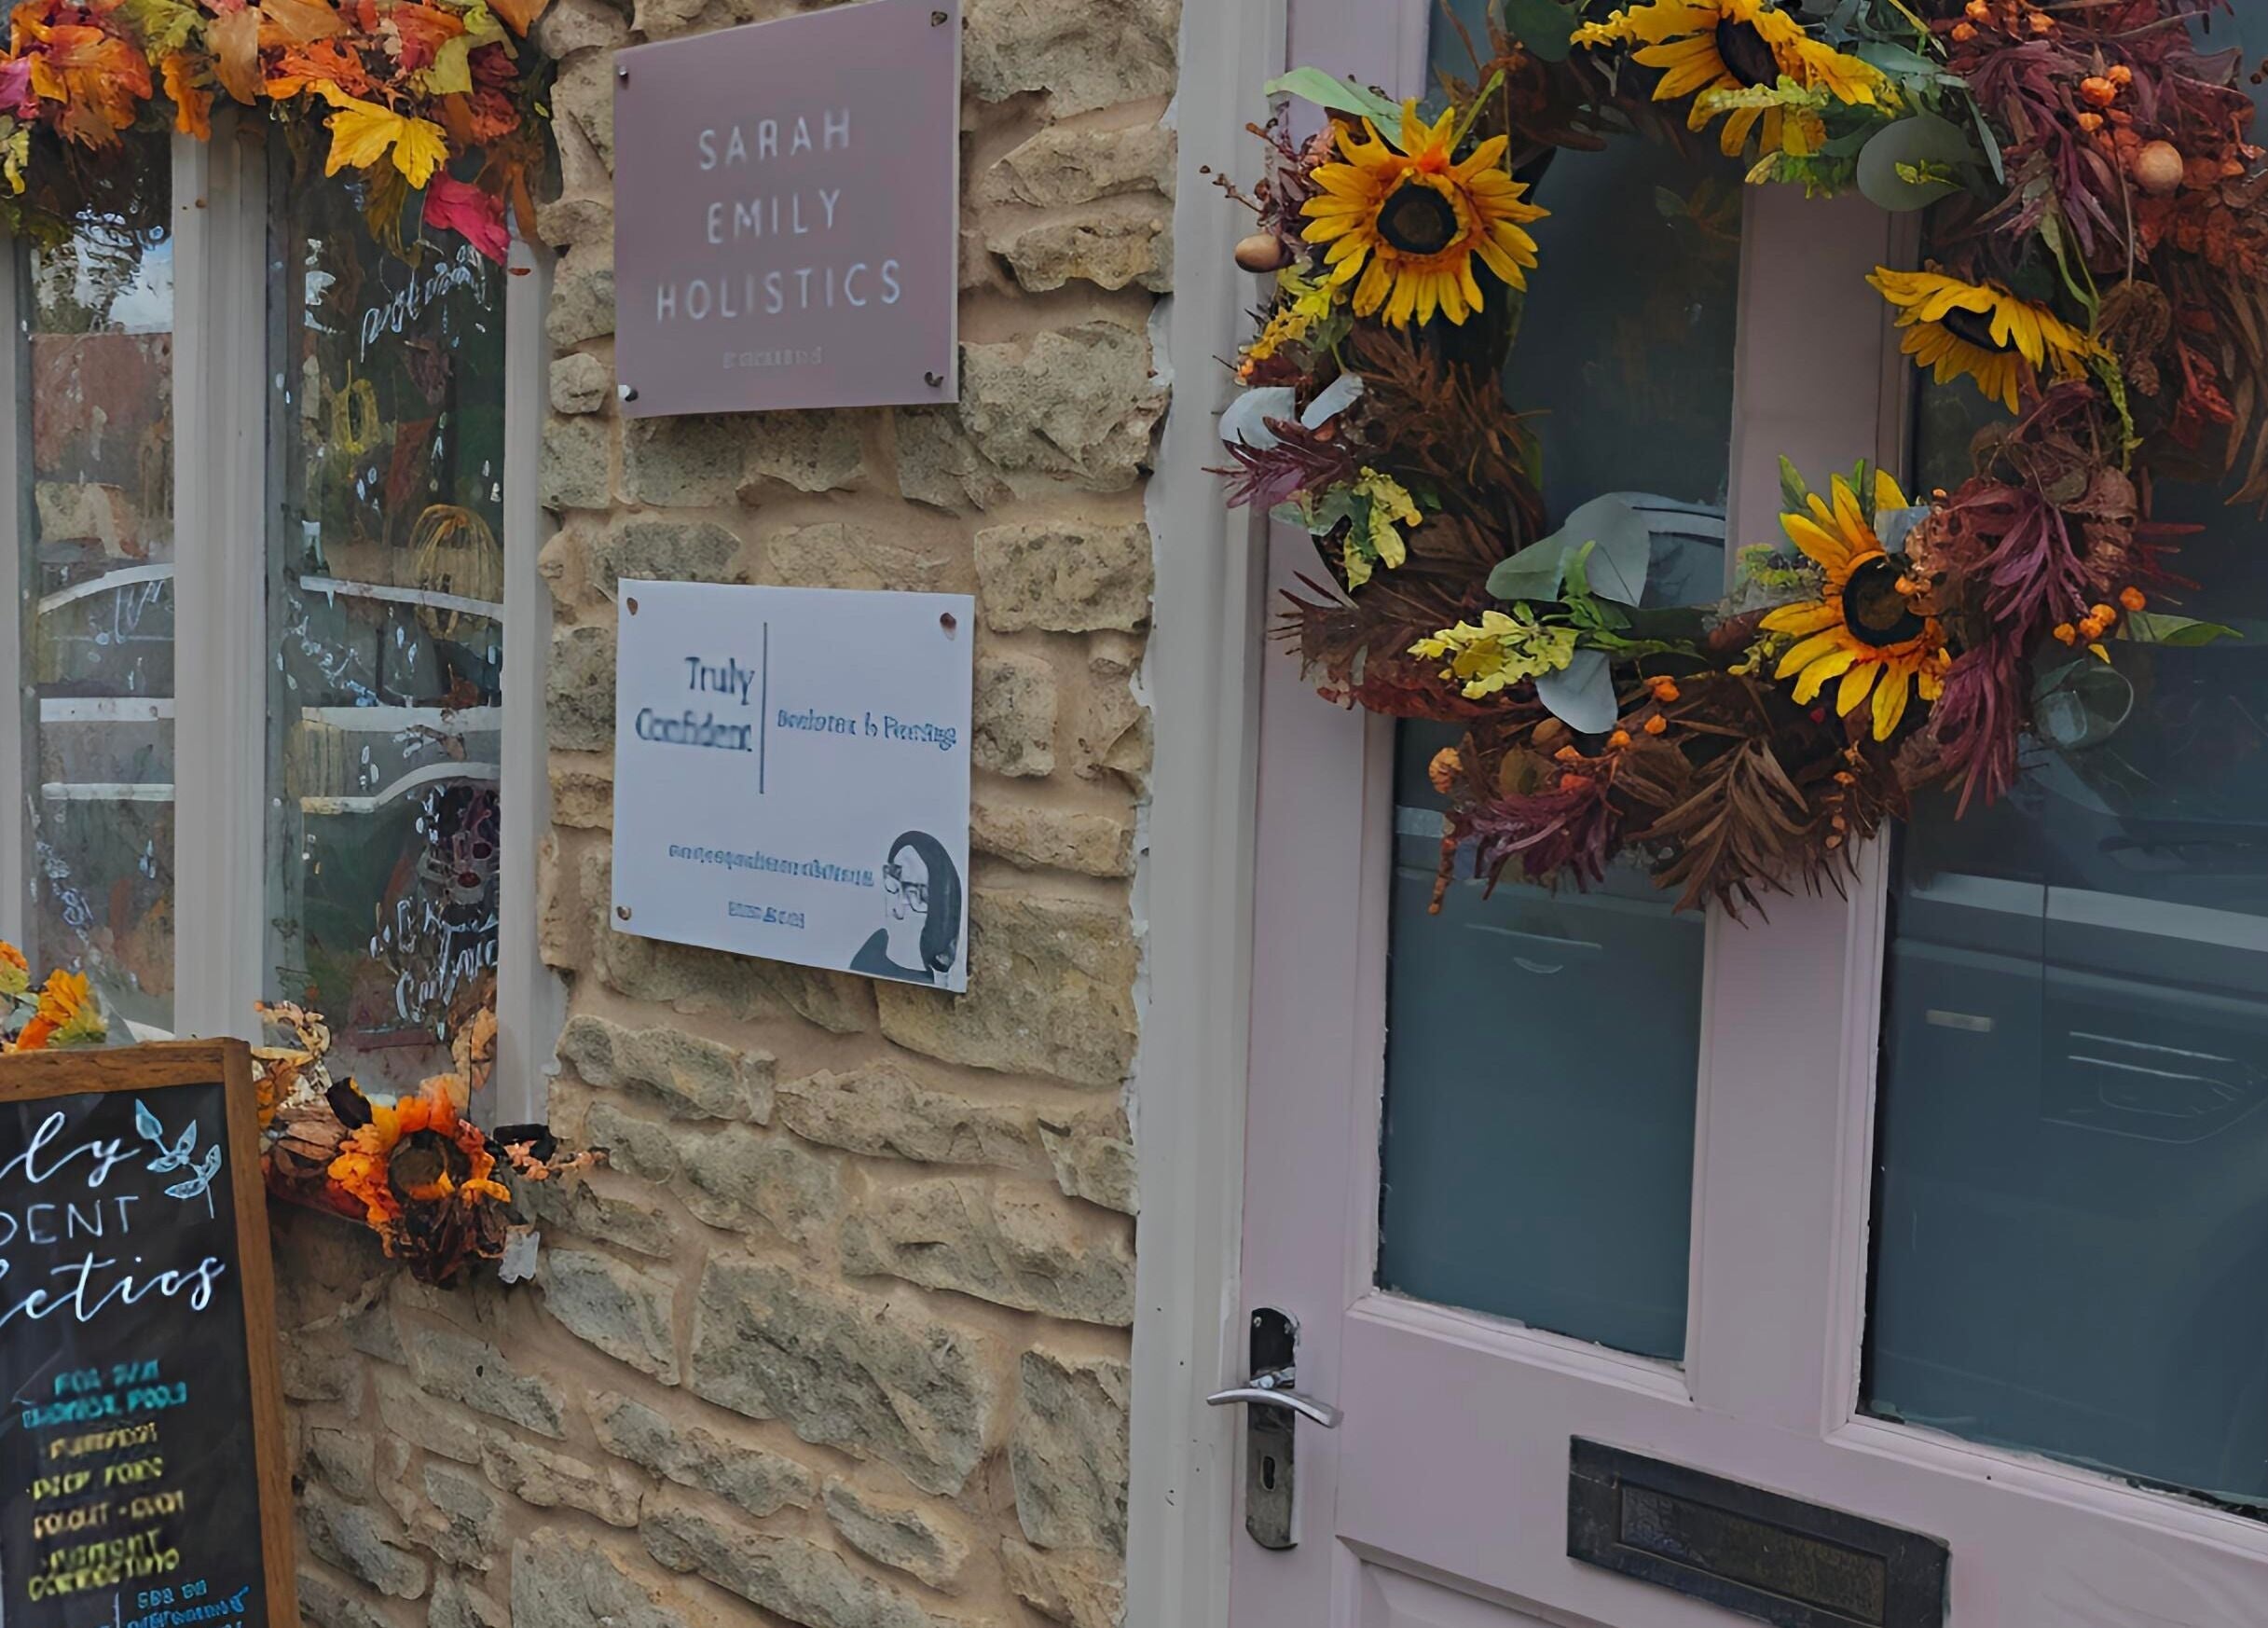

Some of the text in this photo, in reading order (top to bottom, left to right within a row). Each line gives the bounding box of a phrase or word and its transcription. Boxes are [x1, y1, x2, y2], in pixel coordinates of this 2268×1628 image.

[698, 108, 850, 171] SARAH
[707, 188, 840, 244] EMILY
[656, 259, 901, 323] HOLISTICS
[684, 655, 756, 706] Truly
